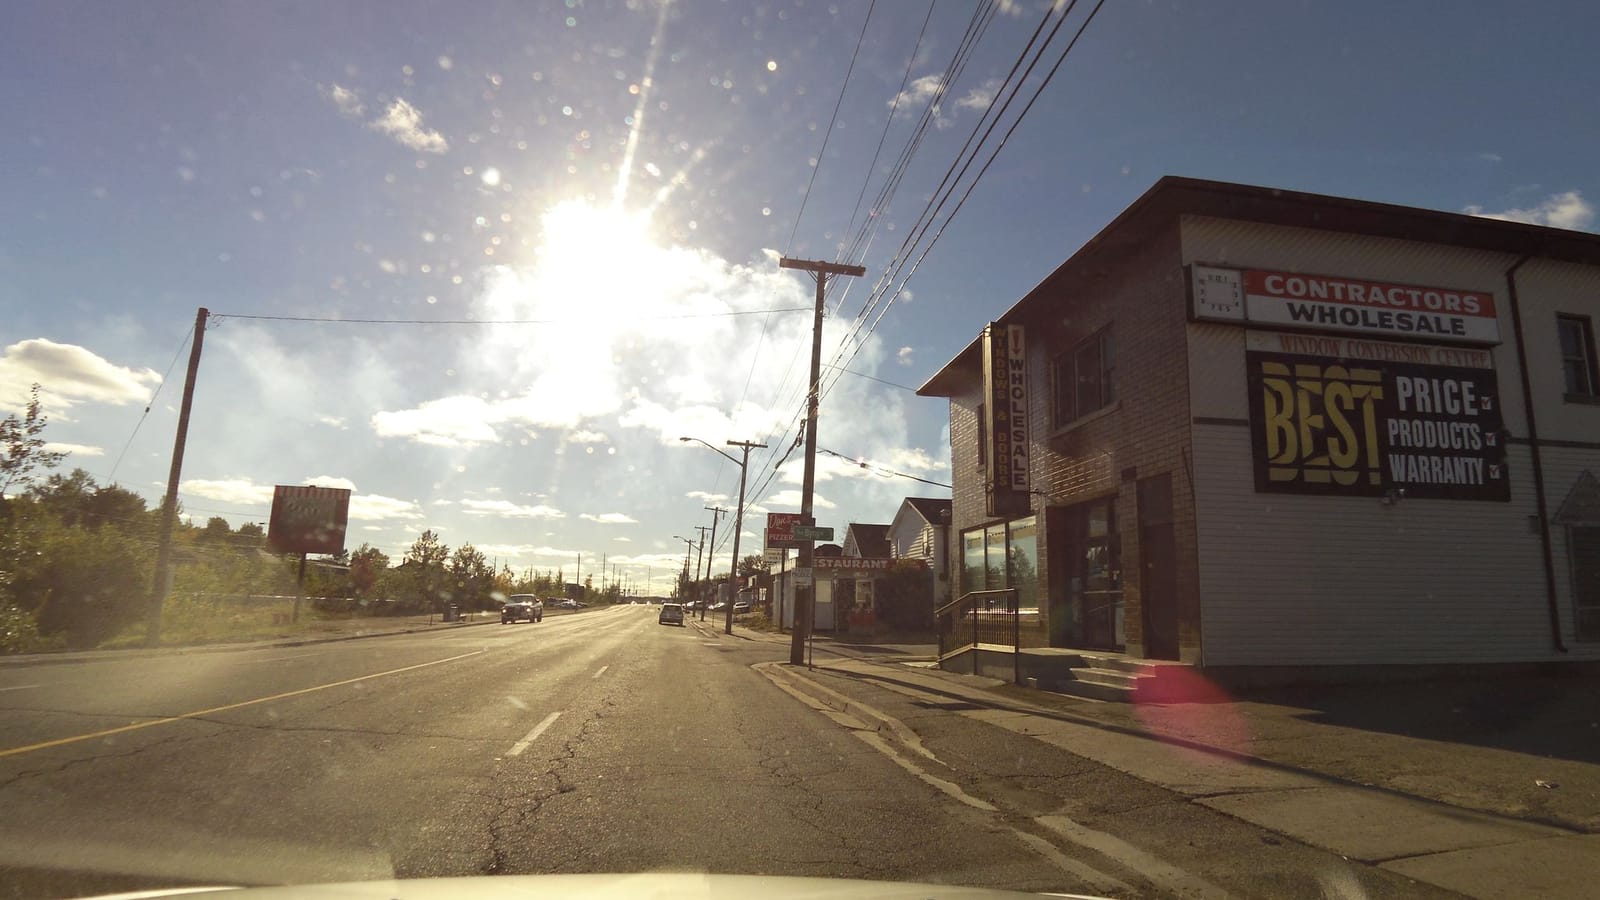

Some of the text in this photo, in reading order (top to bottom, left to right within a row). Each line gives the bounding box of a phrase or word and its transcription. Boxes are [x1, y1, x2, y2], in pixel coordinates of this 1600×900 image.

[1264, 274, 1480, 313] CONTRACTORS
[1287, 302, 1466, 336] WHOLESALE
[1280, 334, 1488, 368] WINDOW CONVERSION CENTRE
[1396, 376, 1479, 416] PRICE
[1009, 359, 1027, 485] WHOLESALE
[1262, 361, 1384, 486] BEST
[1387, 418, 1482, 450] PRODUCTS
[1388, 454, 1484, 485] WARRANTY
[768, 533, 795, 541] PIZZER
[811, 558, 889, 569] ESTAURANT
